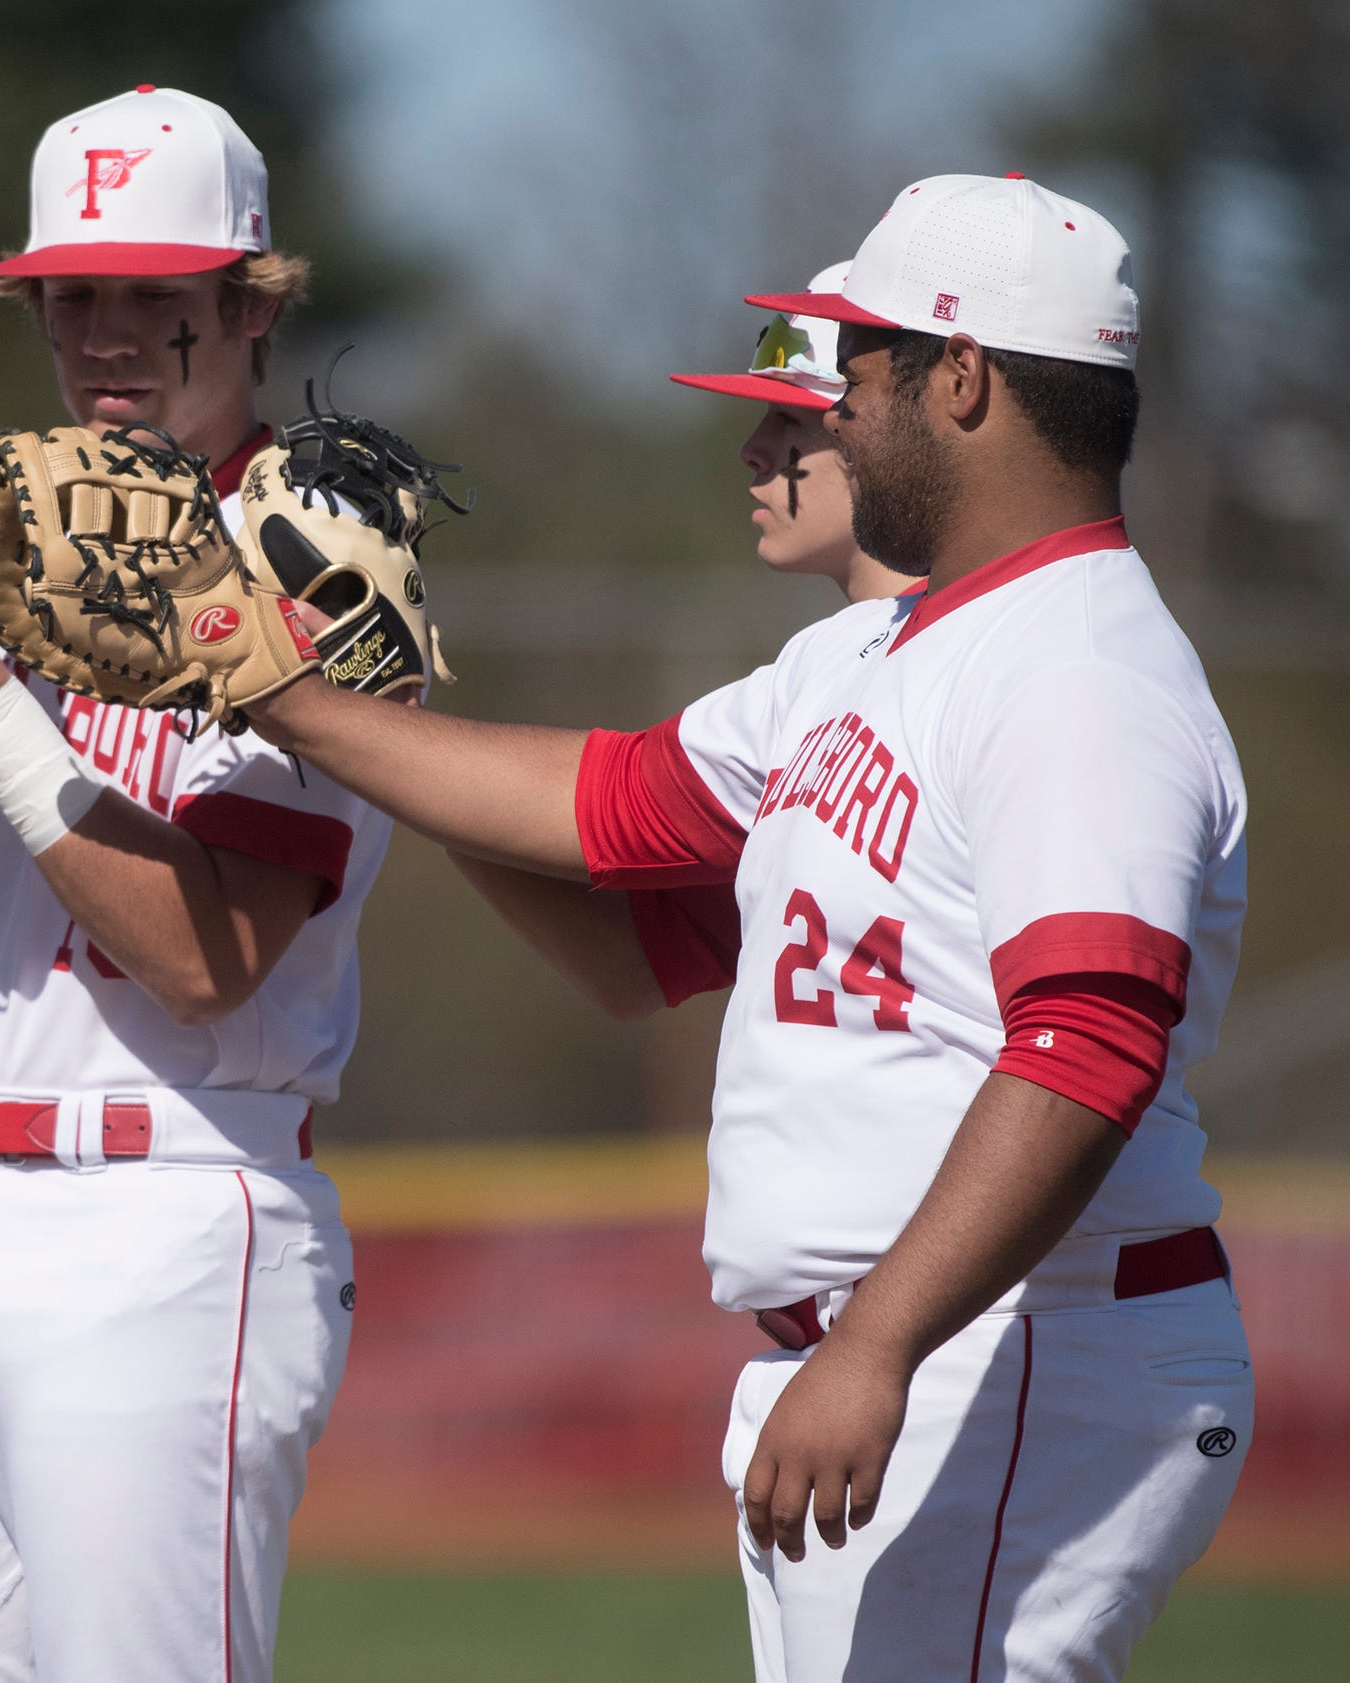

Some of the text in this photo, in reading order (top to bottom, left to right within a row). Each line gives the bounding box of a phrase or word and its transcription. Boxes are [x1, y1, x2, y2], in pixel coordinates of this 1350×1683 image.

[80, 149, 131, 219] P
[1098, 328, 1124, 343] FEAR
[193, 606, 237, 641] R
[324, 630, 387, 687] Rawlings
[773, 888, 916, 1034] 24
